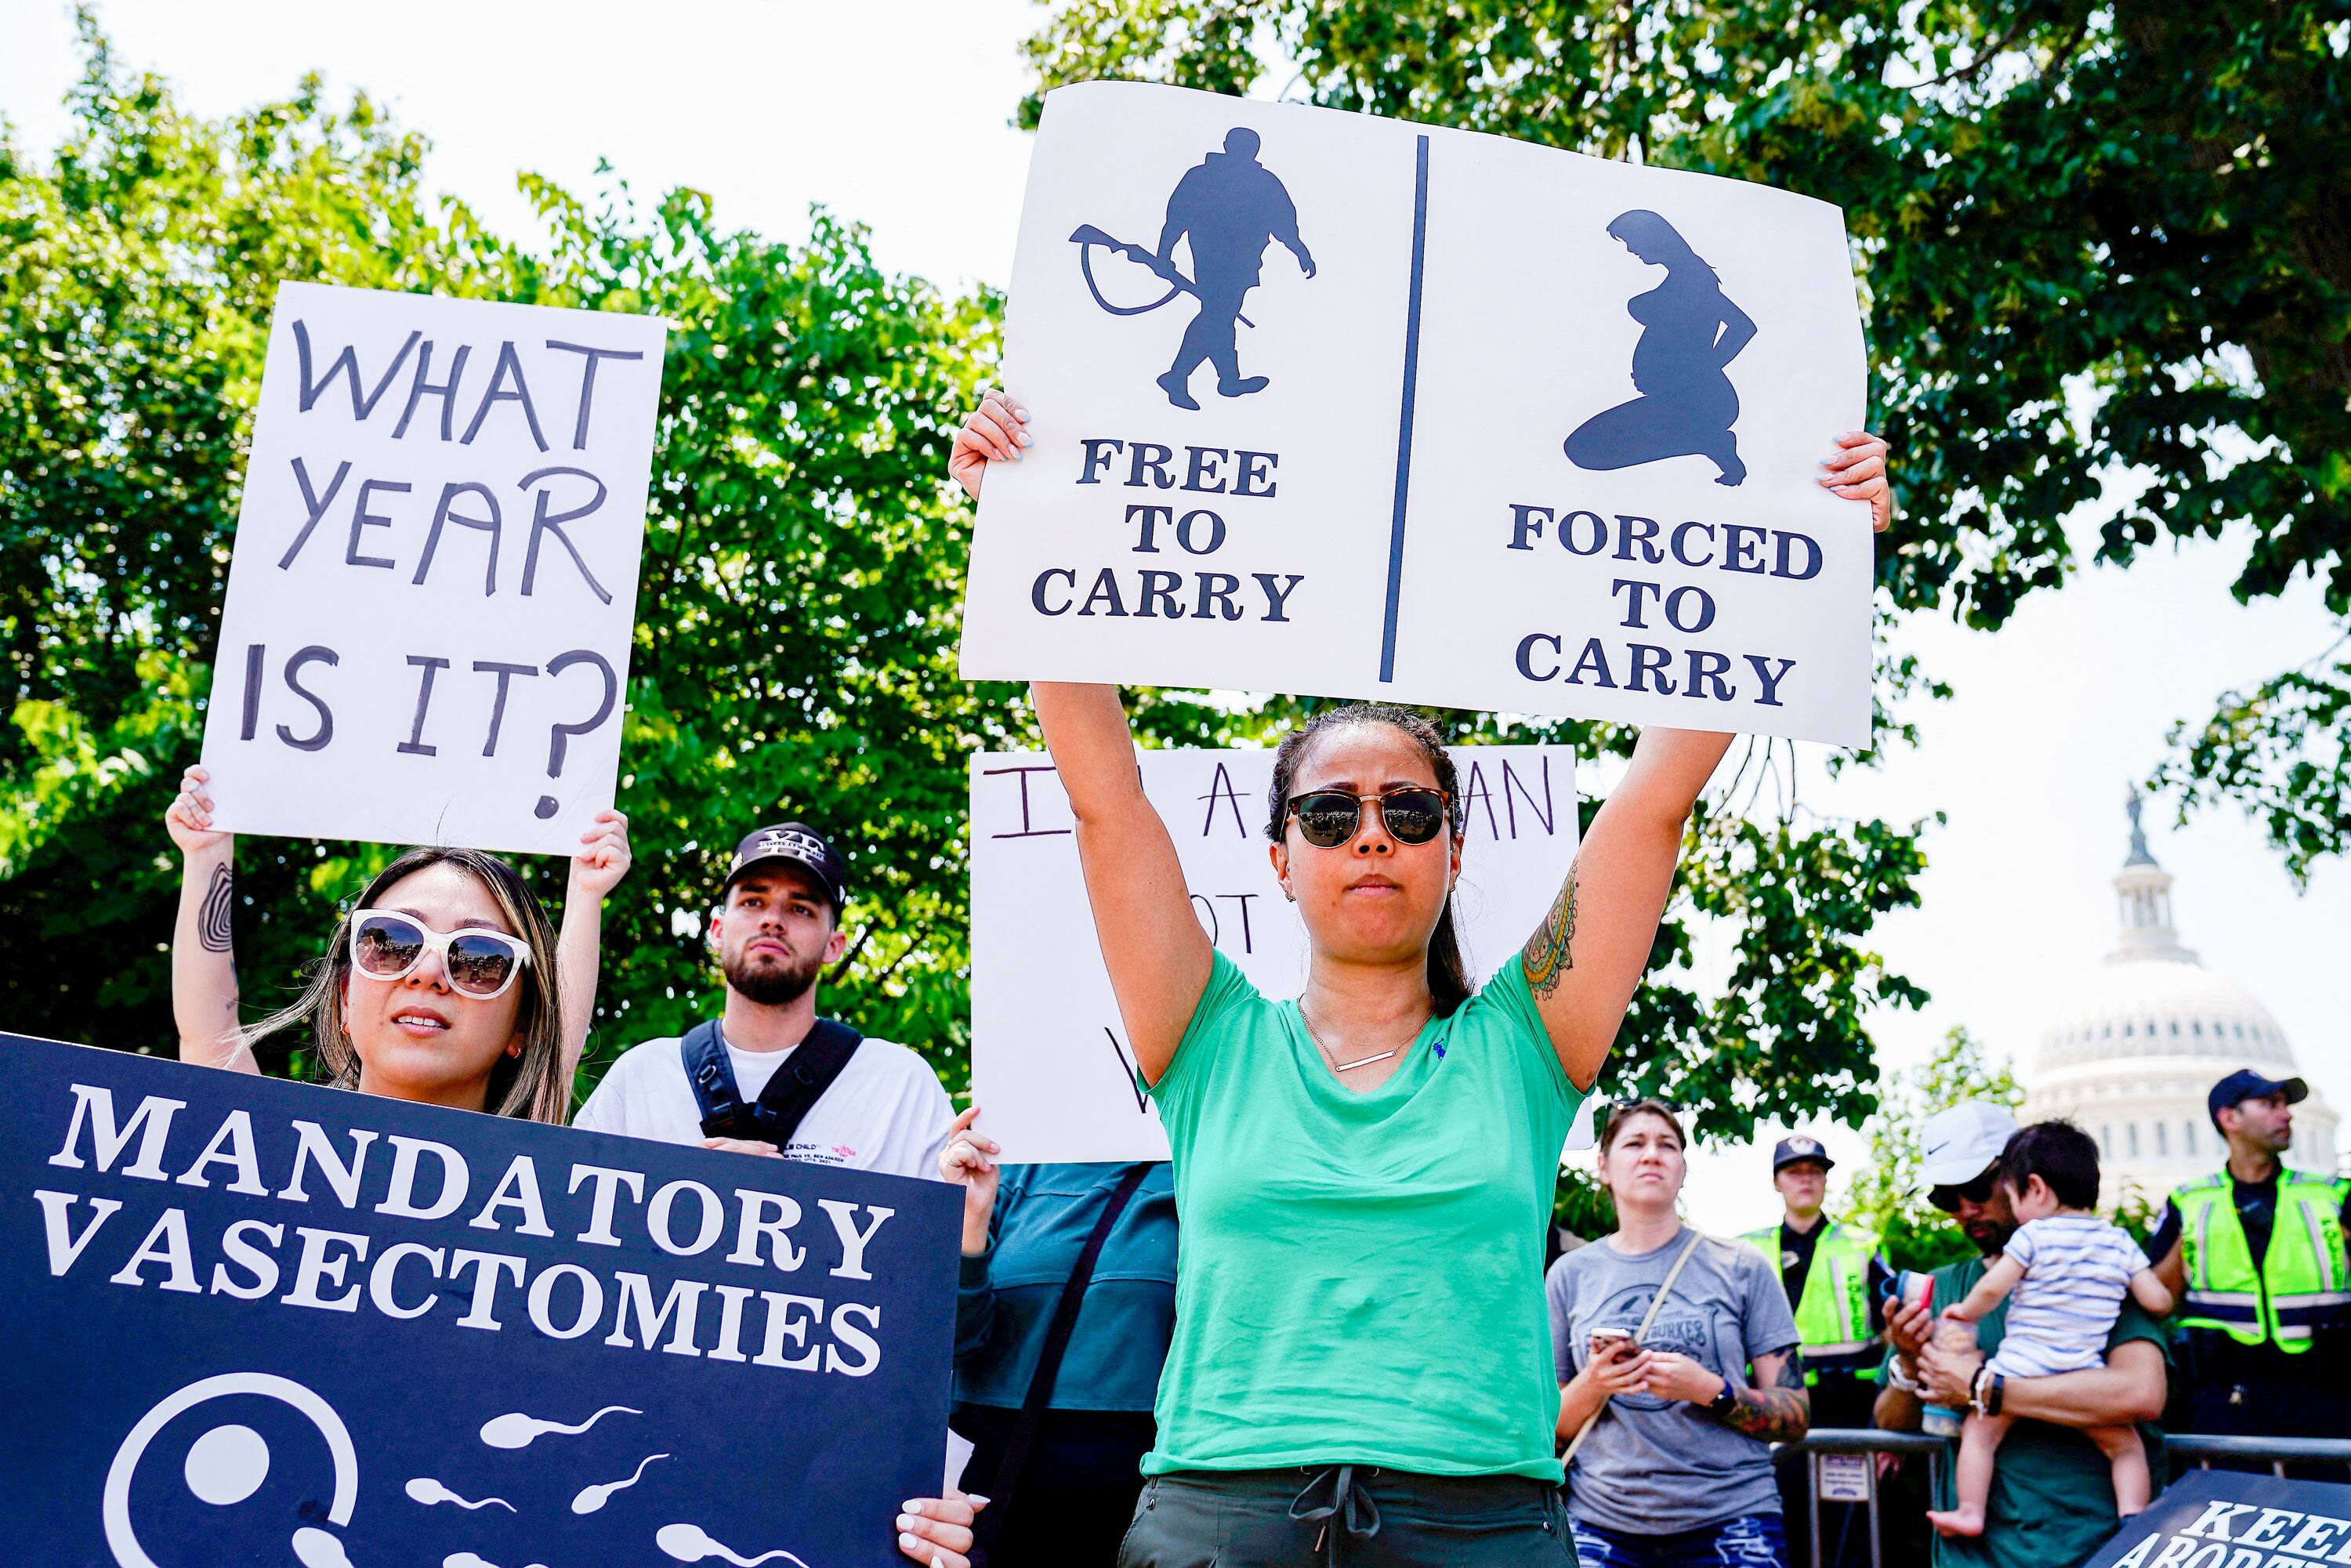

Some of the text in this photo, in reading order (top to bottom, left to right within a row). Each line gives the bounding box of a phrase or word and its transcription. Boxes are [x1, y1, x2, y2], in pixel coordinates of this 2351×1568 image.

[292, 319, 643, 453] WHAT
[1076, 439, 1279, 498] FREE
[277, 456, 614, 606] YEAR
[1125, 504, 1226, 556] TO
[1506, 503, 1823, 581] FORCED
[1031, 568, 1305, 622] CARRY
[1611, 578, 1716, 634] TO
[1515, 633, 1797, 707] CARRY
[240, 643, 618, 820] IS IT?
[1197, 762, 1252, 838] A
[48, 1083, 895, 1281] MANDATORY
[33, 1189, 881, 1377] VASECTOMIES
[2179, 1500, 2351, 1565] KEE
